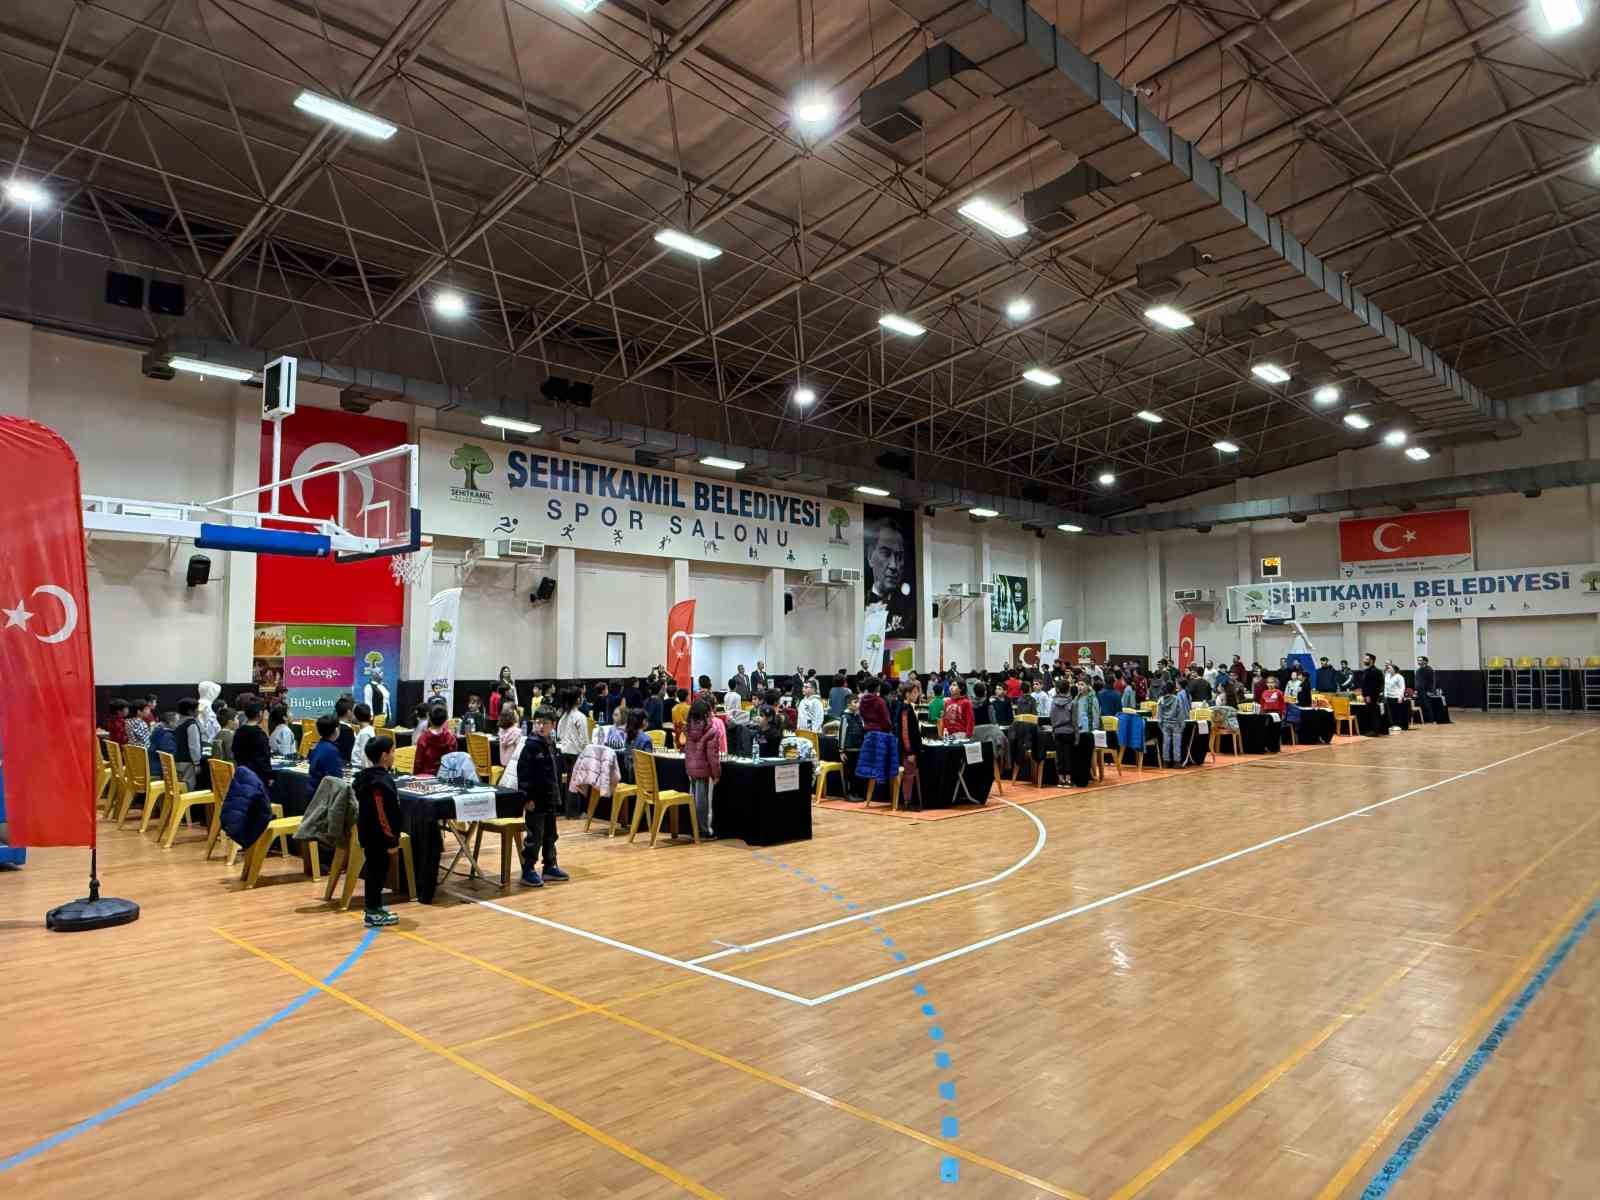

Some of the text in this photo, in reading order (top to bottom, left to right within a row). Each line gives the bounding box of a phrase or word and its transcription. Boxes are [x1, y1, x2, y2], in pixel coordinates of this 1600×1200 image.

[547, 499, 788, 547] SPOR SALONU
[1338, 597, 1473, 610] SPOR SAONU
